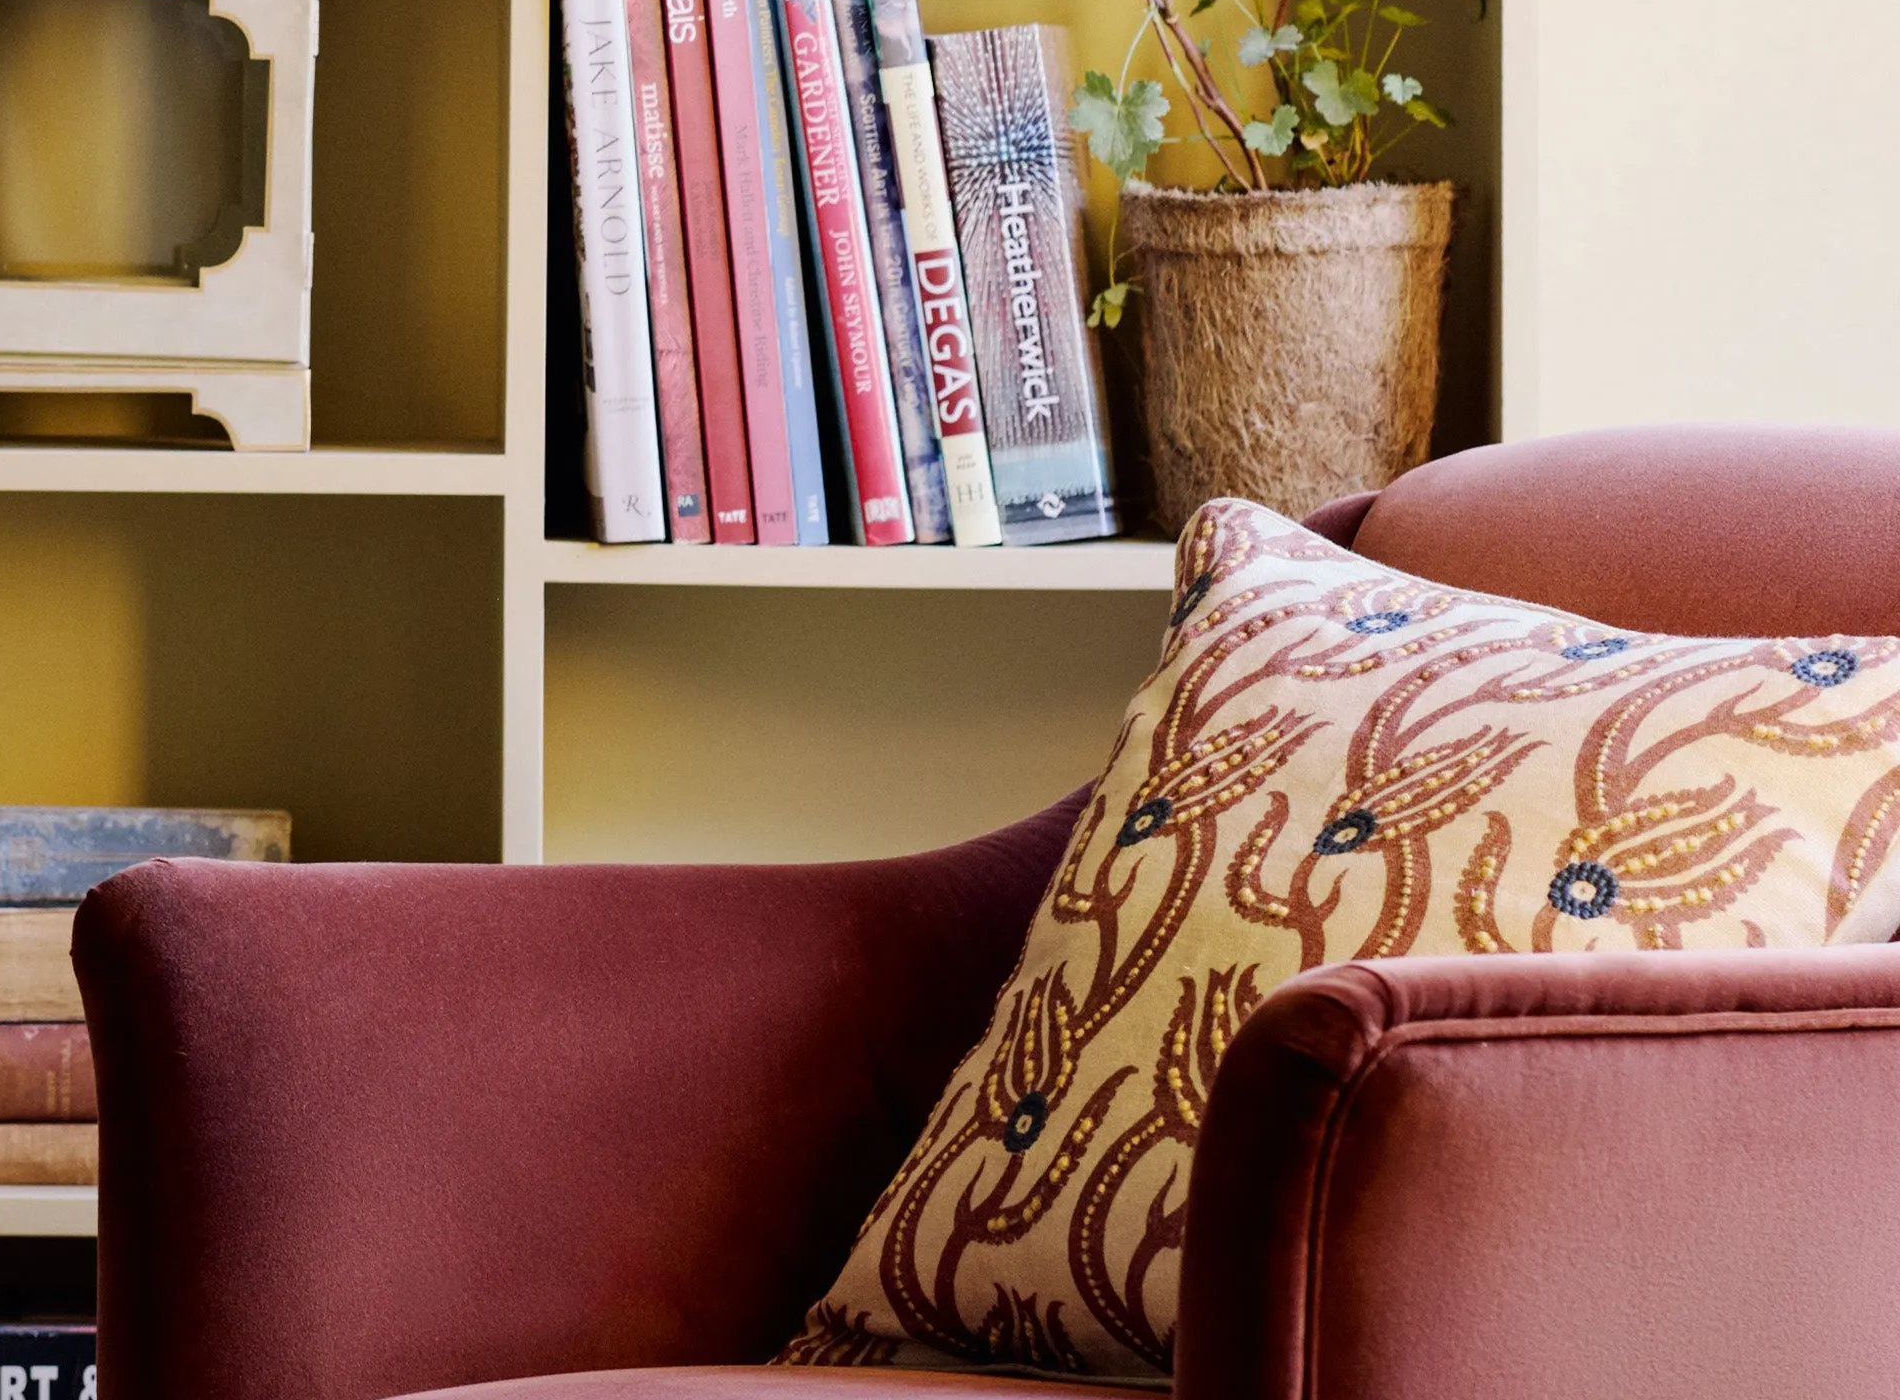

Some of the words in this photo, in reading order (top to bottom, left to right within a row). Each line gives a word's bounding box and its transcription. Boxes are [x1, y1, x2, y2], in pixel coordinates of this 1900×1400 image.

[580, 18, 618, 107] JAKE
[902, 71, 917, 100] THE
[640, 82, 668, 178] matisse
[792, 31, 843, 210] GARDENER
[906, 104, 920, 132] LIFE
[734, 124, 751, 169] Mark
[910, 132, 926, 163] AND
[594, 128, 632, 297] ARNOLD
[737, 170, 756, 226] Hallett
[916, 167, 934, 221] WORKS
[742, 228, 759, 256] and
[829, 229, 854, 287] JOHN
[925, 224, 940, 243] OF
[745, 259, 766, 330] Christine
[997, 180, 1062, 424] Heatherwick
[751, 335, 772, 389] Riding
[841, 292, 874, 396] SEYMOUR
[916, 260, 979, 425] DEGAS
[717, 509, 748, 524] TATE
